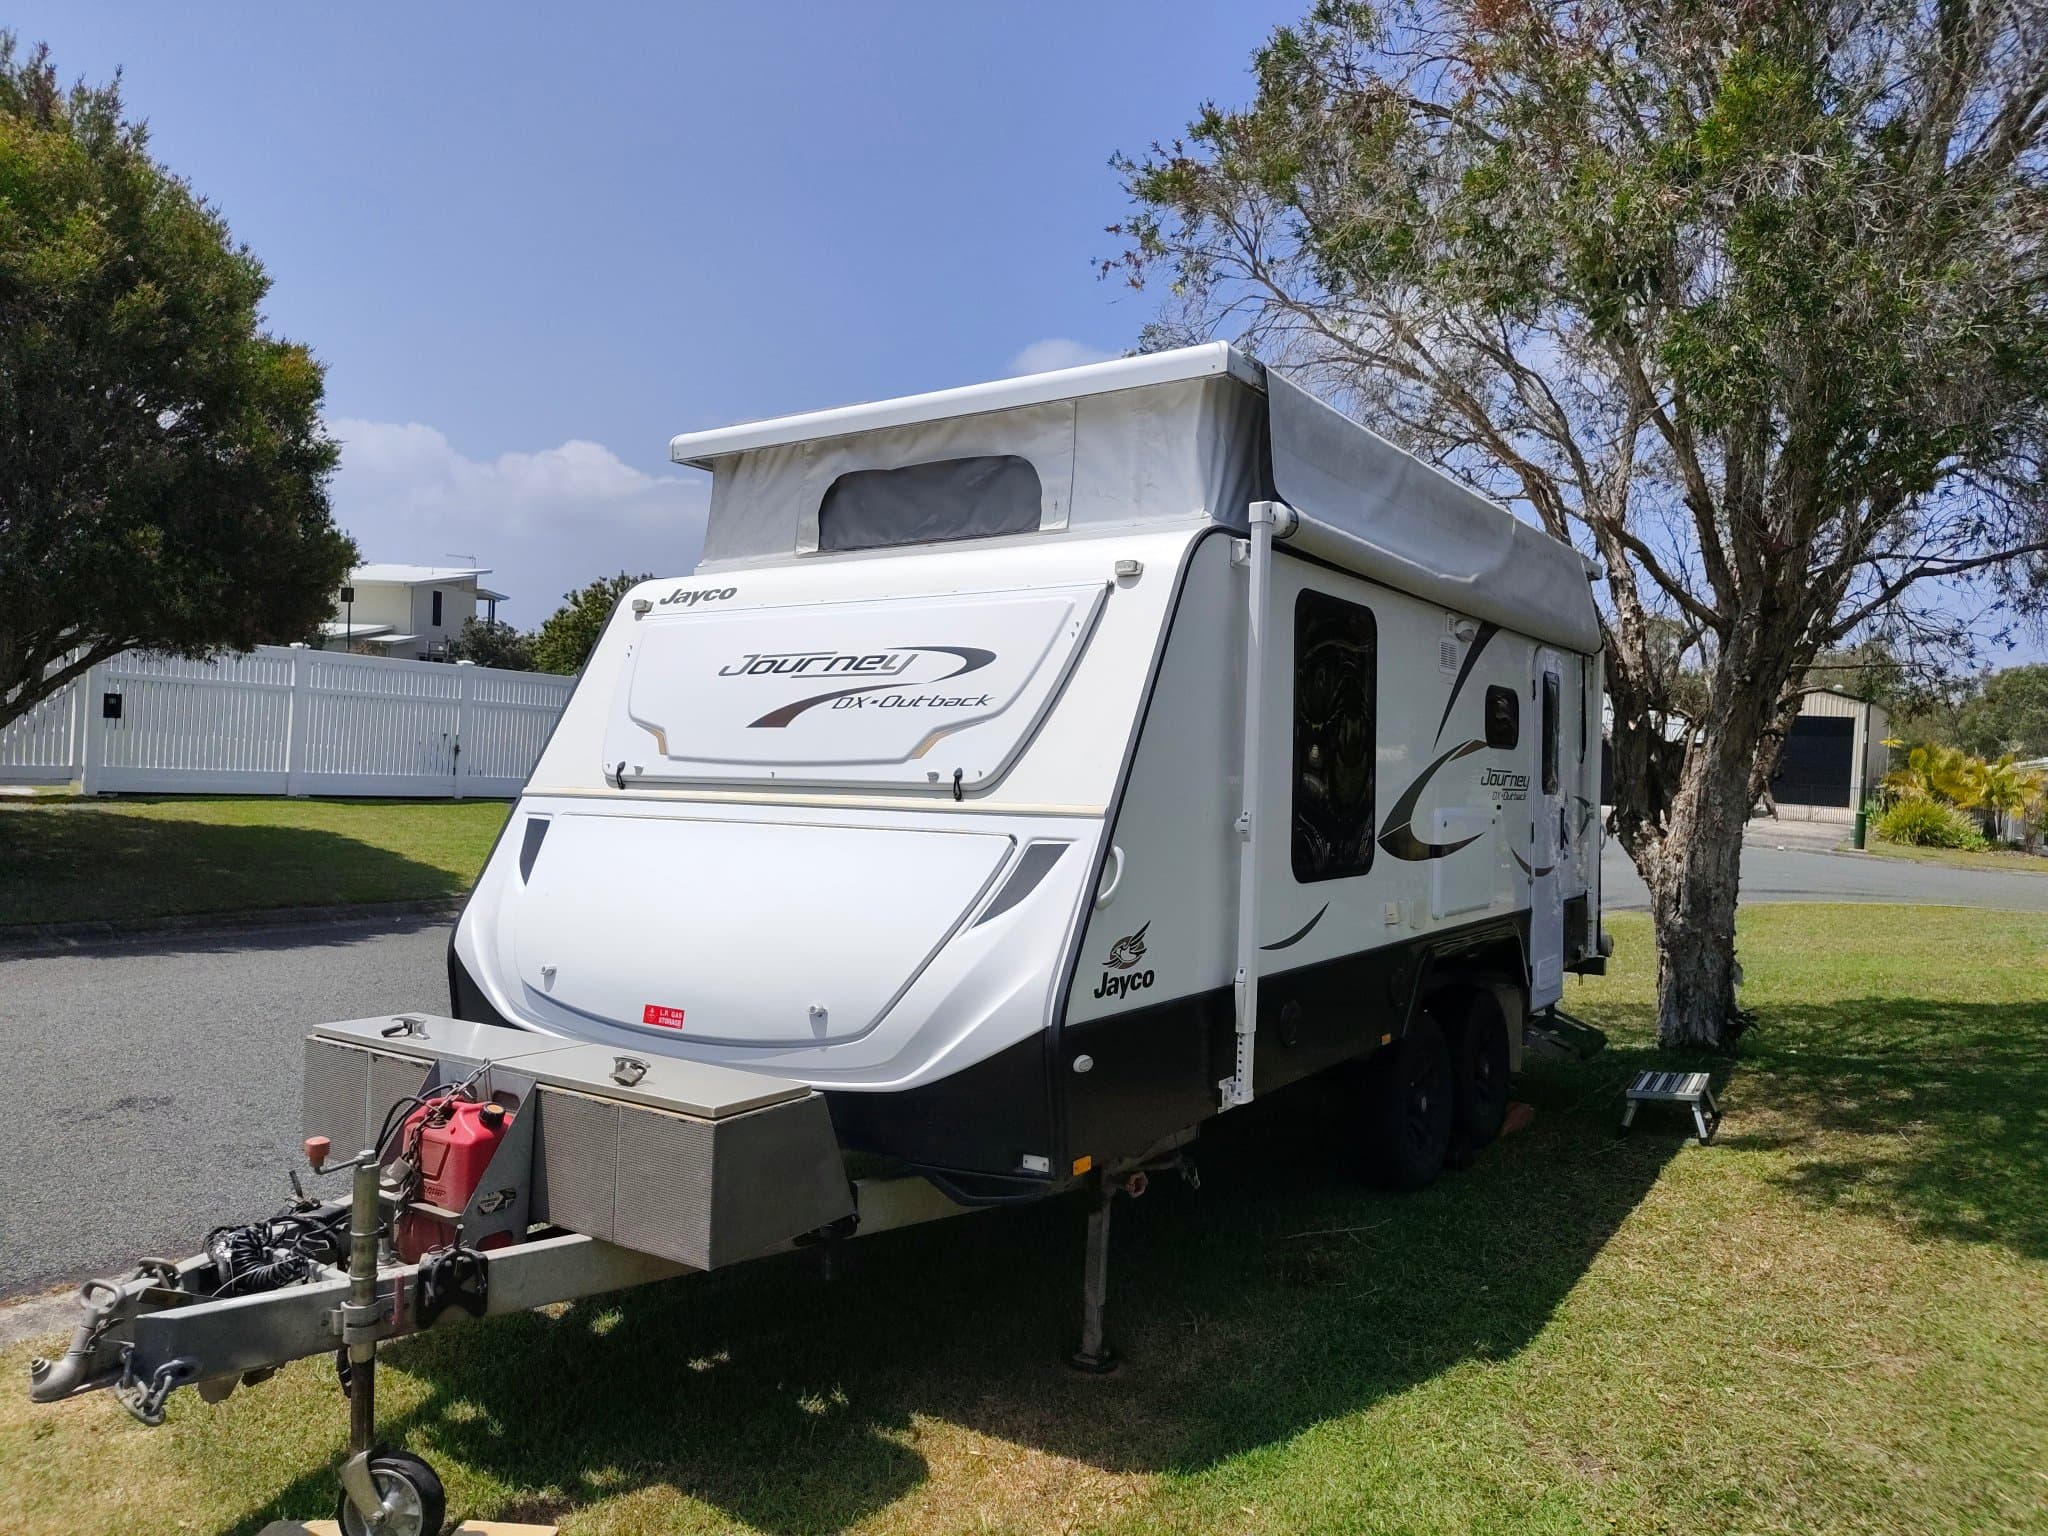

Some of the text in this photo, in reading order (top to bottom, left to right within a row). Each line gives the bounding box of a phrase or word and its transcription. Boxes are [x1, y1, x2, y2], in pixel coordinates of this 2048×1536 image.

[659, 587, 738, 607] Jayco
[718, 652, 919, 678] Journey
[1480, 767, 1530, 791] Journey
[1093, 969, 1155, 1000] Jayco
[658, 1017, 682, 1027] STORAGE
[671, 1011, 683, 1019] GAS
